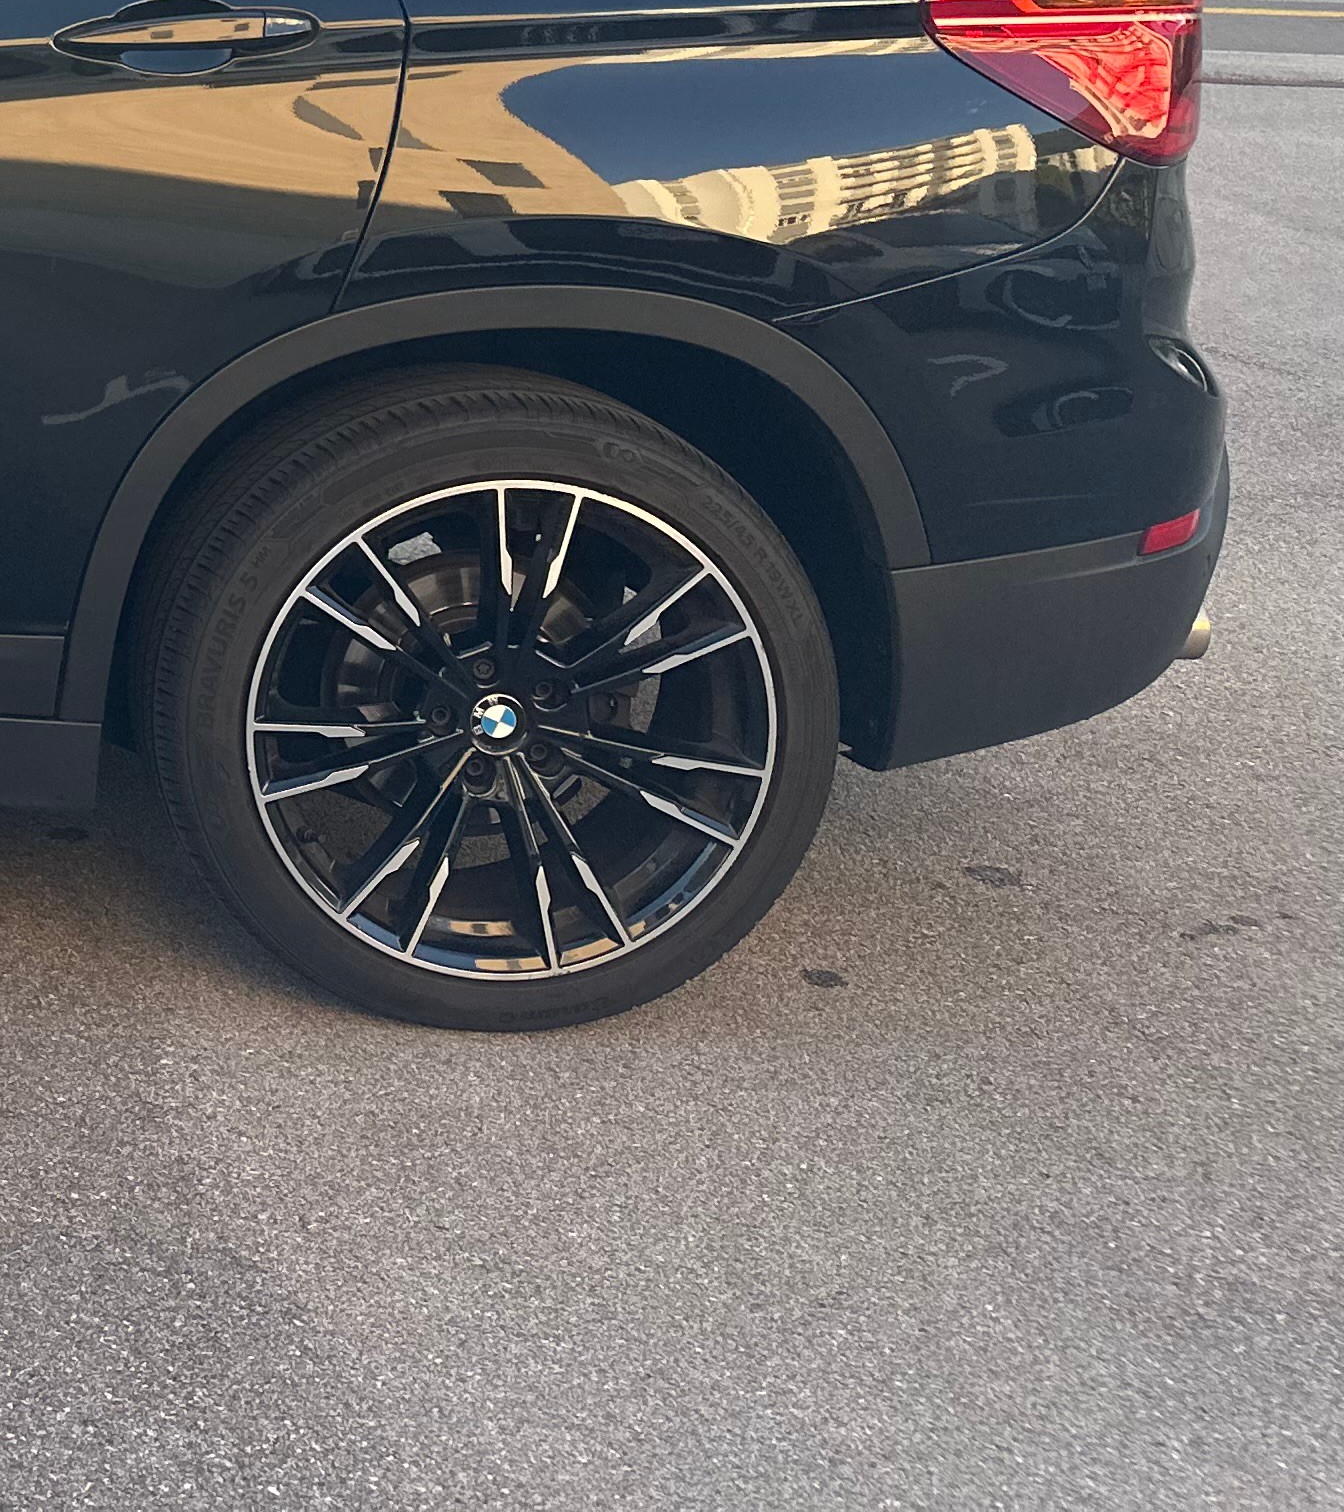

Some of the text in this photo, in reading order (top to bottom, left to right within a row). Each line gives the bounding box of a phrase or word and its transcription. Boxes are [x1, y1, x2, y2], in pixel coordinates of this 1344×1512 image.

[700, 495, 756, 548] 225/45
[196, 592, 246, 730] BRAVURIS
[239, 570, 259, 593] 5
